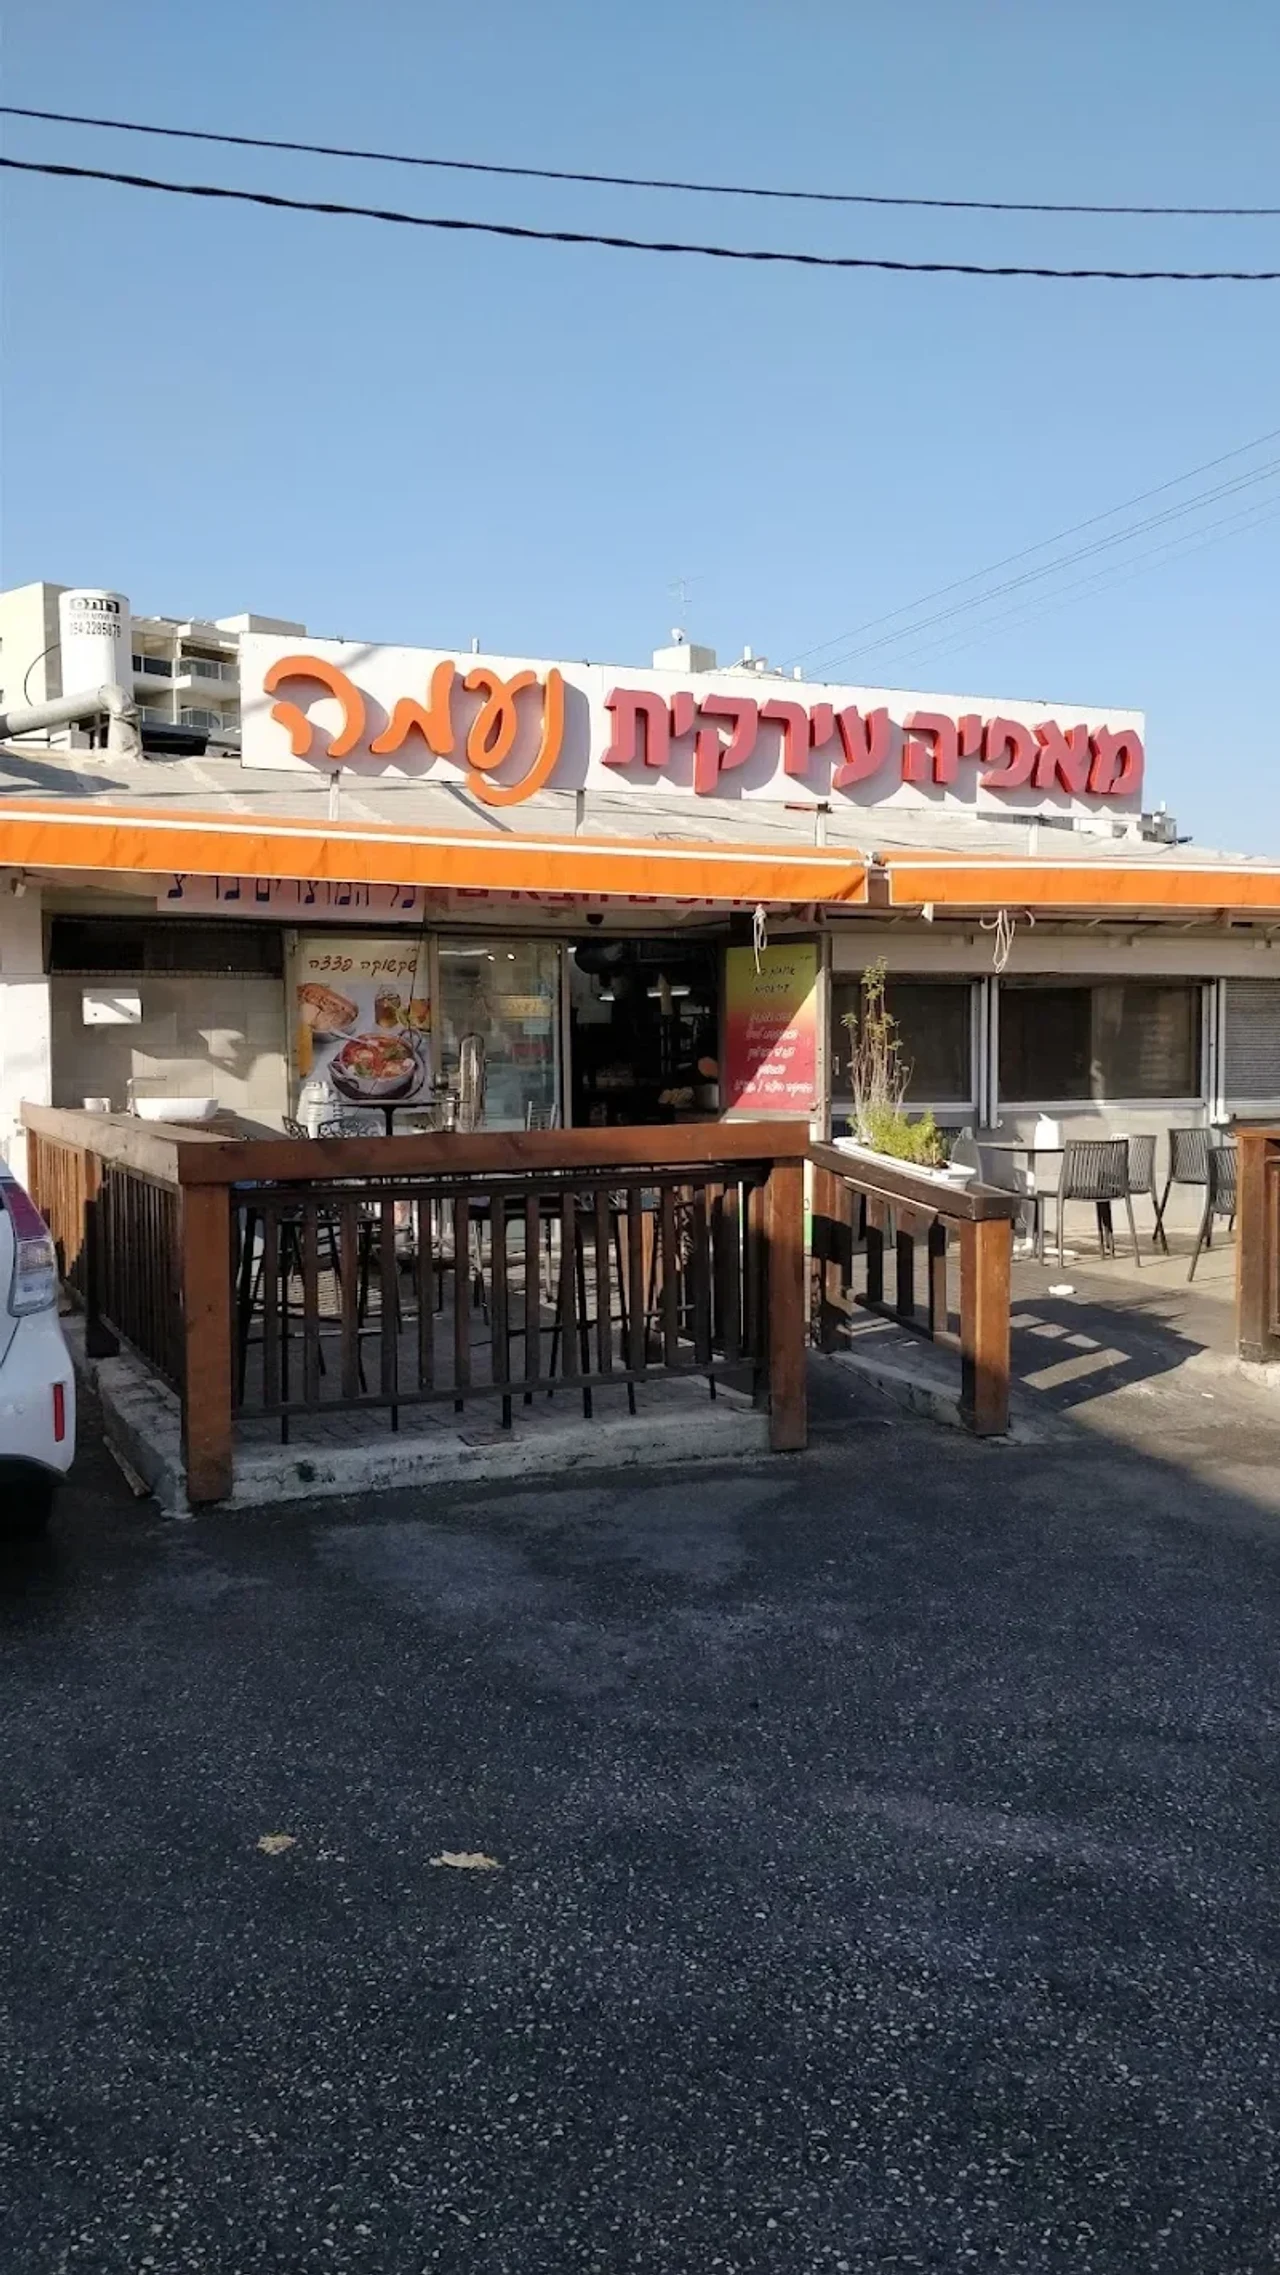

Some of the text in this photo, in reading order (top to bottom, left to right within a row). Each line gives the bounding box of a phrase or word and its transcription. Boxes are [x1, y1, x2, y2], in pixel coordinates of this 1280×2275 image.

[263, 655, 1145, 807] מאפיה עירקית נעמה
[308, 955, 418, 977] שקשוקה פצצה
